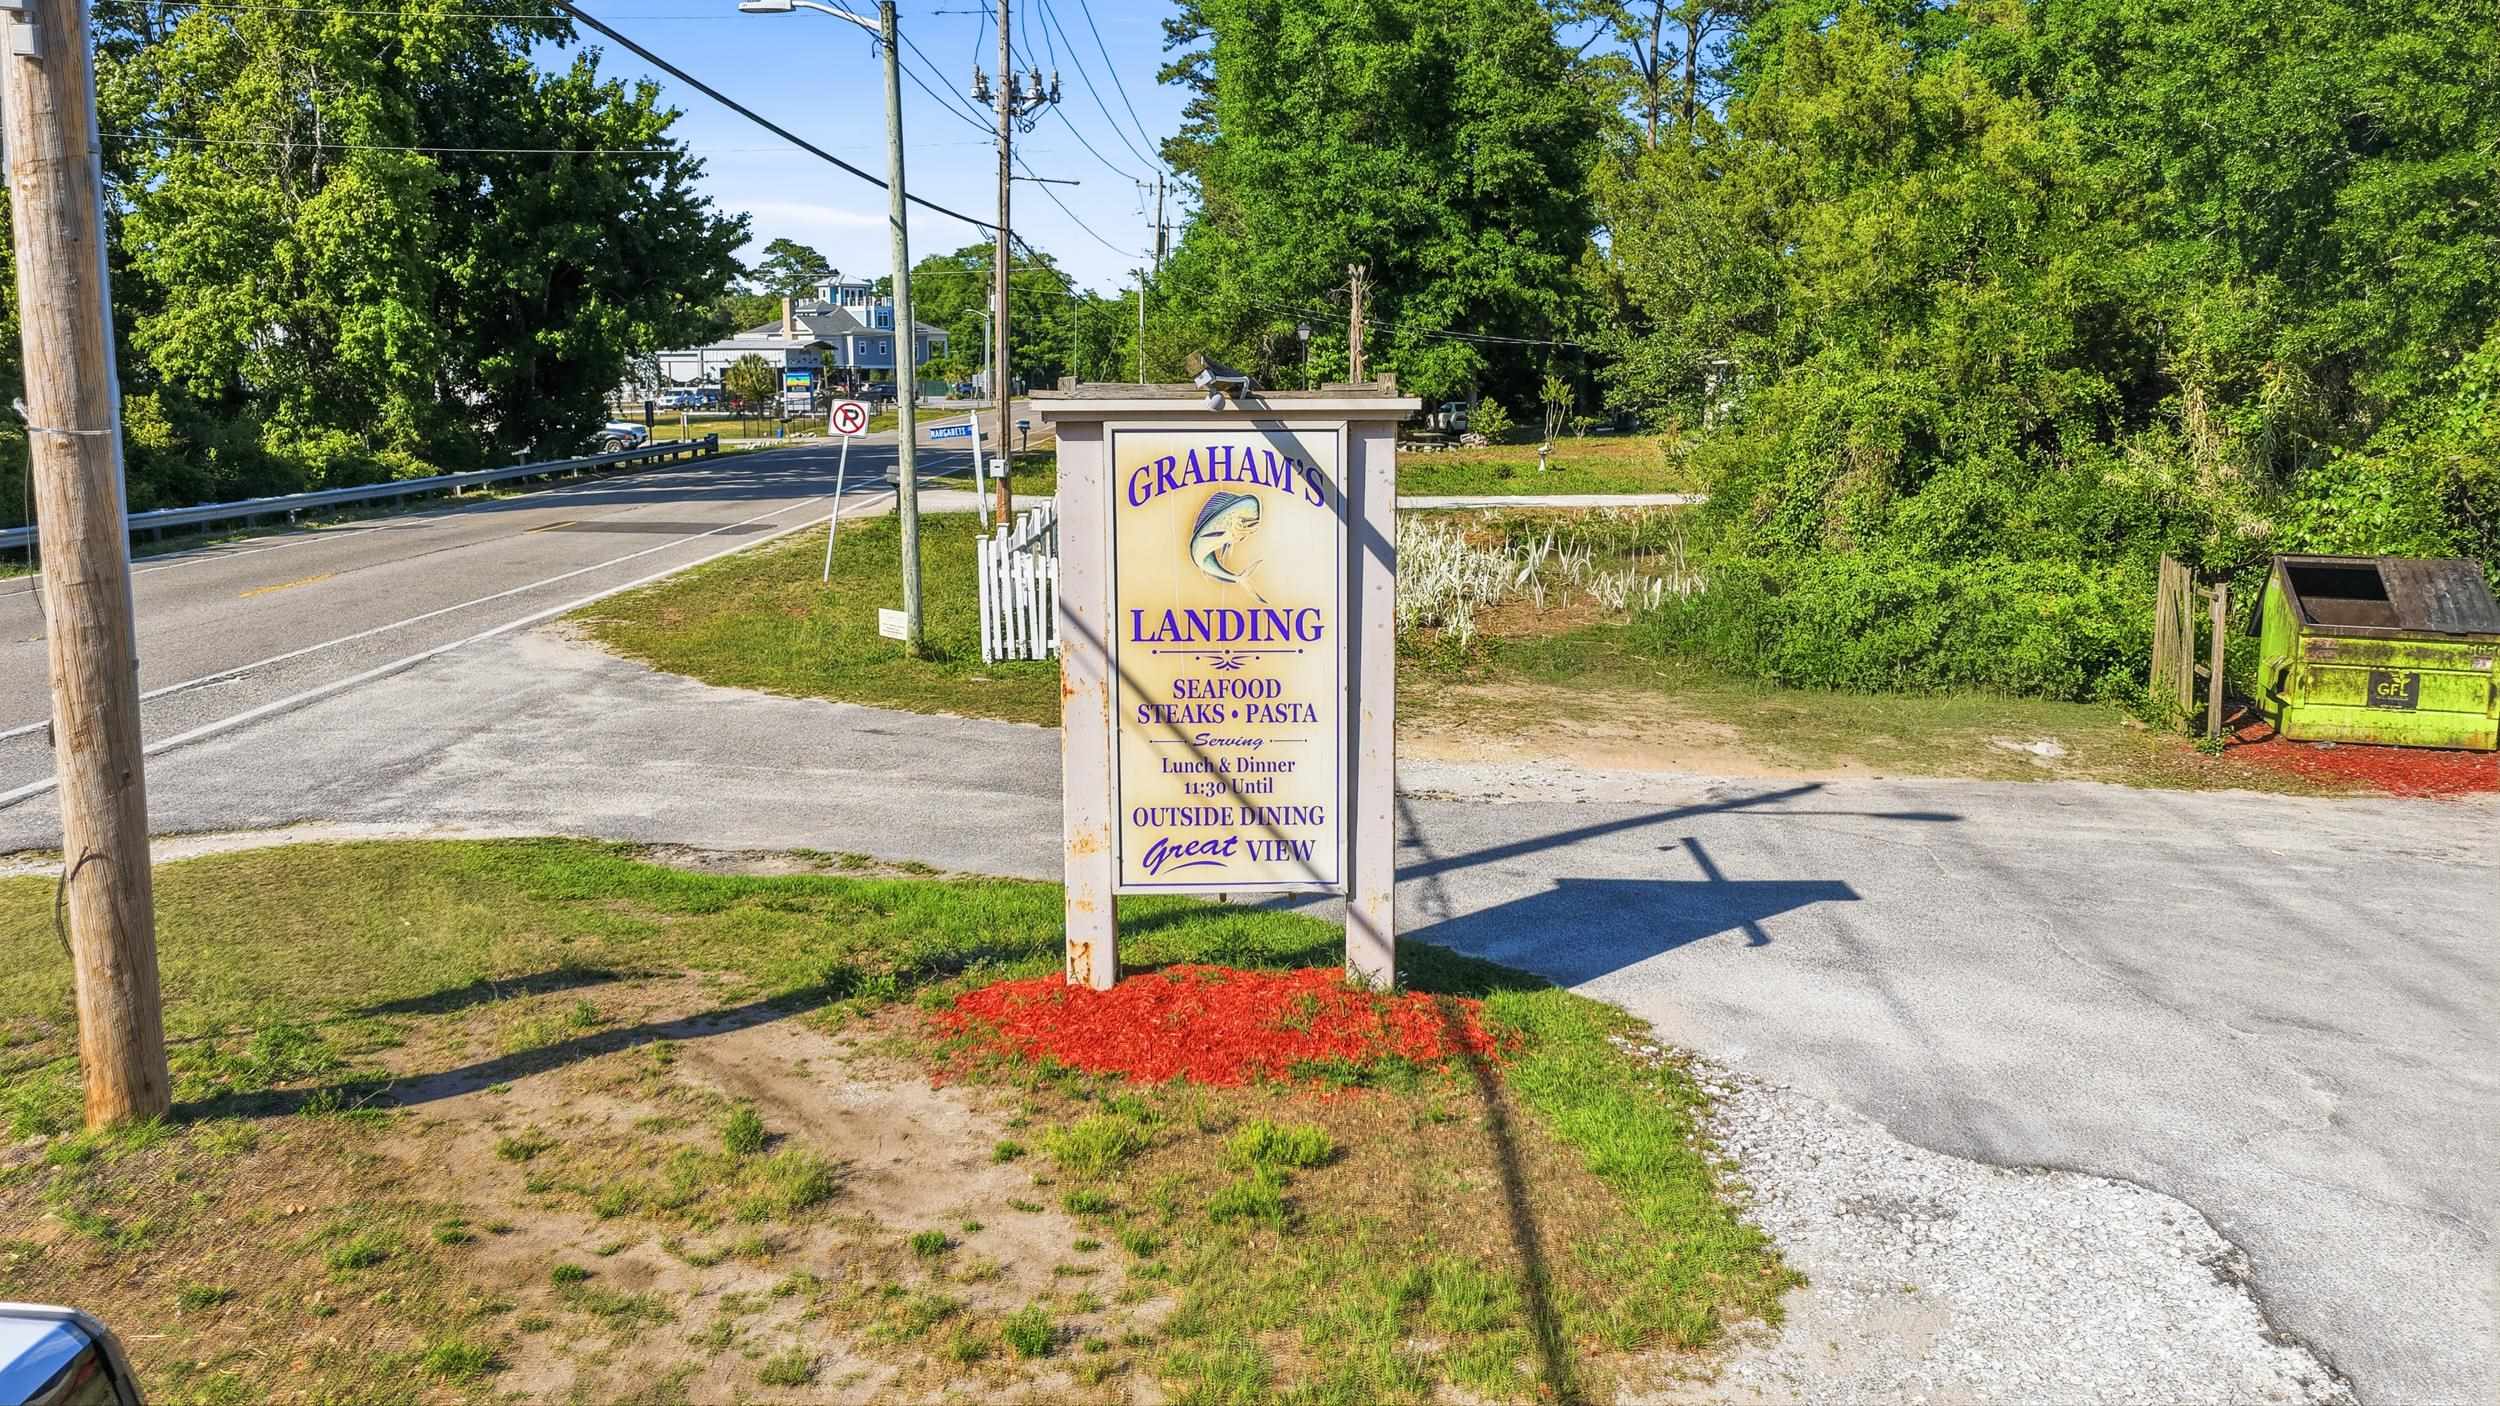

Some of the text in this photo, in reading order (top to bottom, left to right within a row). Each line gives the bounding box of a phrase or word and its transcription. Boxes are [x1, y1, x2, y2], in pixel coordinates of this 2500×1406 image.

[1128, 445, 1326, 508] GRAHAM'S
[1130, 607, 1325, 643] LANDING
[1173, 679, 1282, 699] SEAFOOD
[2377, 681, 2409, 697] GFL
[1137, 703, 1318, 724] STEAKS PASTA
[1192, 733, 1265, 751] Serving
[1162, 756, 1296, 774] Lunch & Dinner
[1184, 777, 1273, 797] 11:30 Until
[1132, 806, 1326, 827] OUTSIDE DINING
[1142, 835, 1316, 876] Great VIEW
